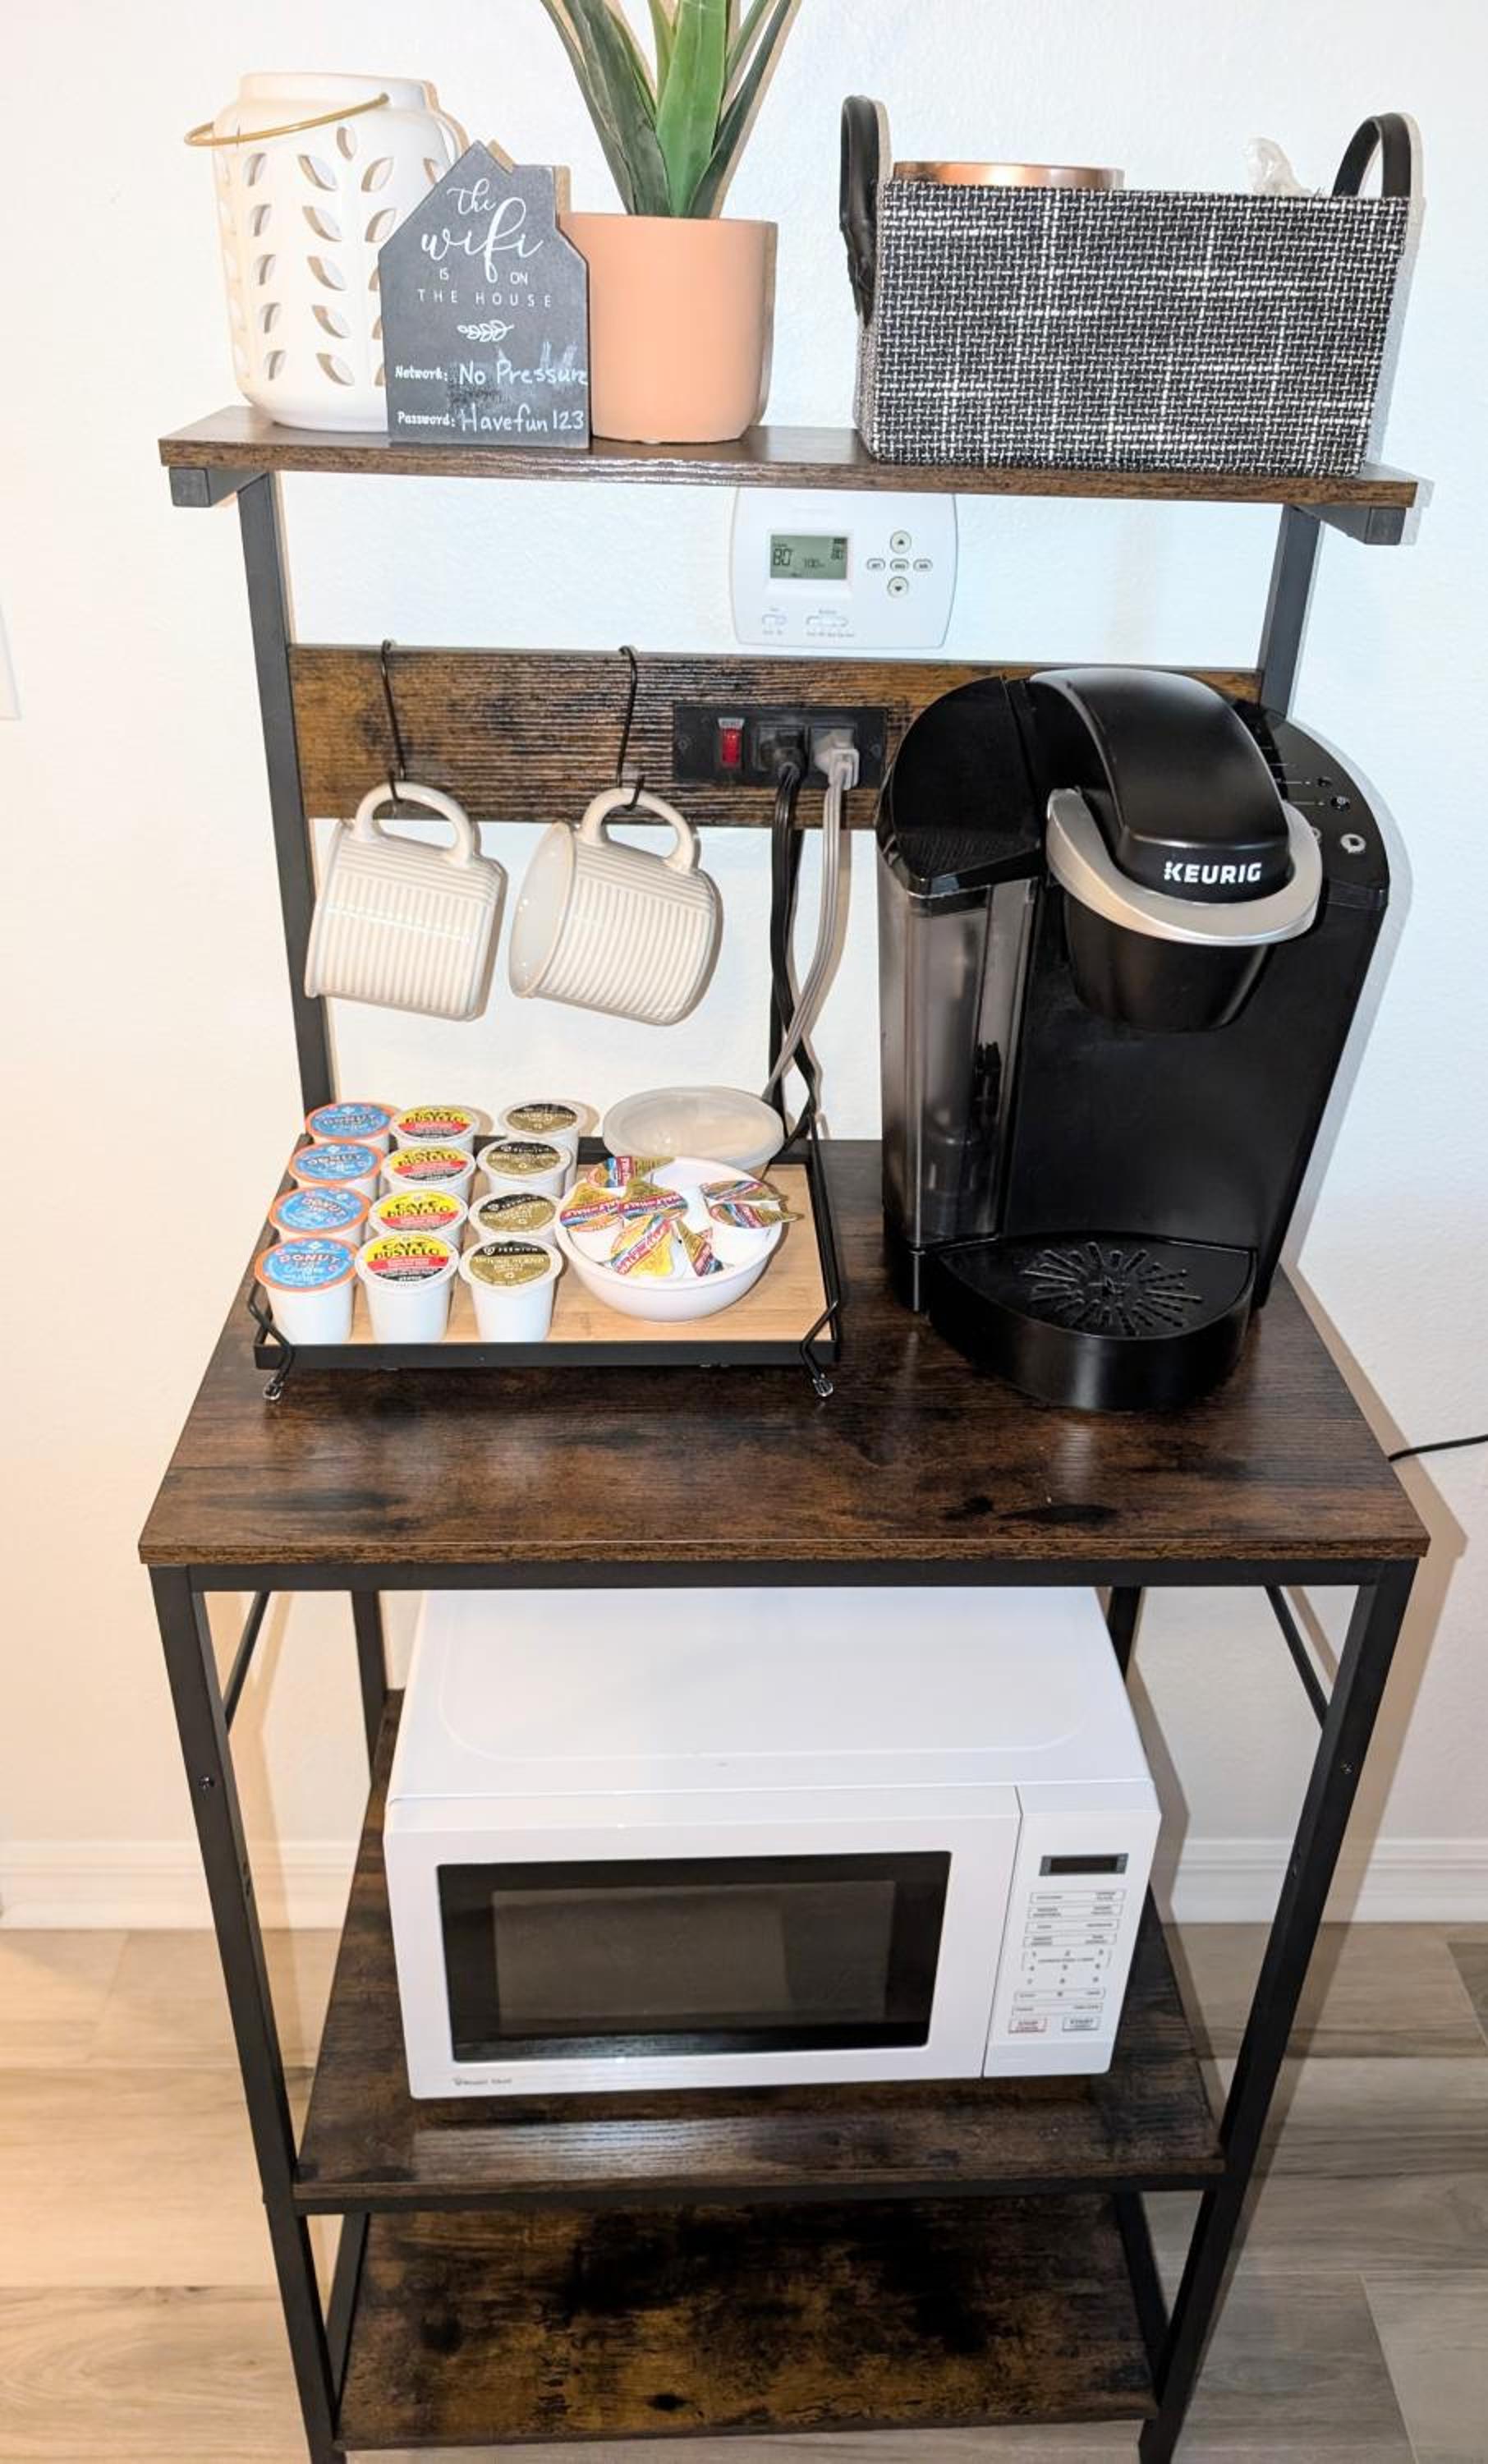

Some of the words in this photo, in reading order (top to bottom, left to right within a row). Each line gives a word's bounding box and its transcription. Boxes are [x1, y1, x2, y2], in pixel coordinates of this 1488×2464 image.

[447, 177, 496, 214] the
[421, 197, 543, 283] wifi
[439, 268, 449, 280] IS
[510, 273, 528, 286] ON
[417, 288, 457, 303] THE
[475, 292, 551, 308] HOUSE
[395, 365, 448, 382] Network:
[459, 360, 486, 384] No
[497, 359, 589, 384] Pressure
[397, 411, 456, 427] Password:
[1164, 861, 1262, 884] KEURIG
